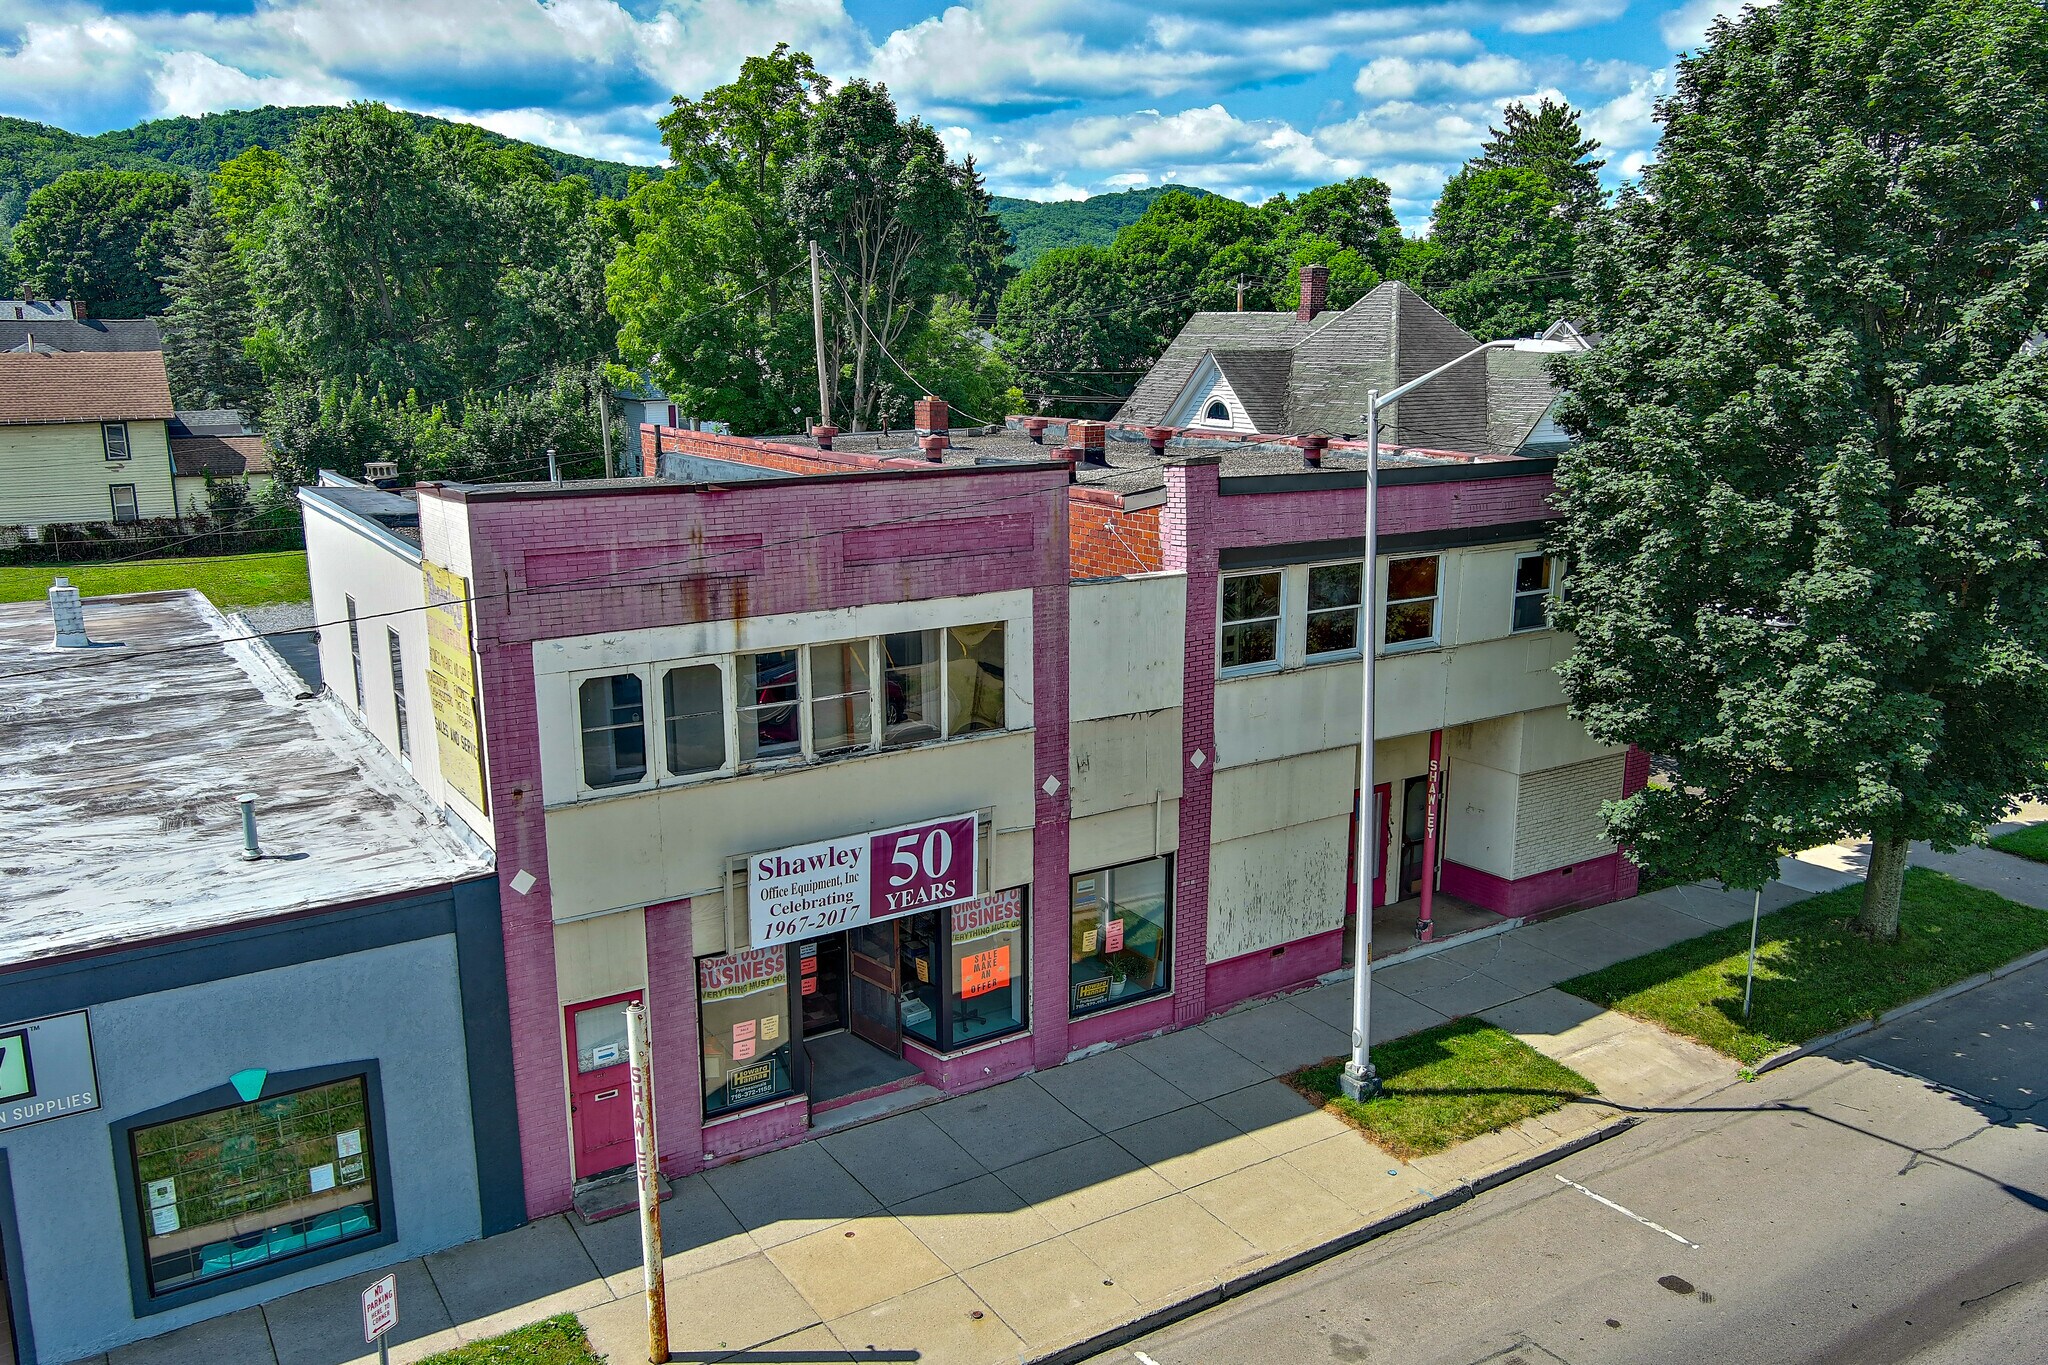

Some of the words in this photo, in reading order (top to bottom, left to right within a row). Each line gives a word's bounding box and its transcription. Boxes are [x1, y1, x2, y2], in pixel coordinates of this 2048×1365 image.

[1427, 760, 1438, 838] SHAWLEY
[758, 846, 863, 881] Shawley
[889, 828, 953, 887] 50
[760, 886, 789, 901] Office
[791, 876, 843, 897] Equipment,
[845, 871, 860, 884] Inc
[885, 879, 956, 911] YEARS
[770, 891, 854, 917] Celebrating
[952, 899, 981, 914] OING
[763, 904, 861, 940] 1967-2017
[992, 920, 1010, 933] MUST
[973, 958, 997, 973] MAKE
[974, 949, 998, 963] SALE
[701, 954, 785, 989] BUSINESS
[749, 978, 770, 990] MUST
[772, 973, 786, 984] GO!
[981, 969, 991, 980] AN
[970, 978, 997, 994] OFFER
[734, 1065, 768, 1086] Howard
[12, 1092, 92, 1121] SUPPLIES
[631, 1067, 648, 1191] SHAWLEY
[366, 1290, 393, 1313] PARKING
[374, 1284, 383, 1298] NO
[371, 1306, 383, 1319] HERE
[384, 1302, 390, 1310] TO
[373, 1310, 390, 1326] CORNER
